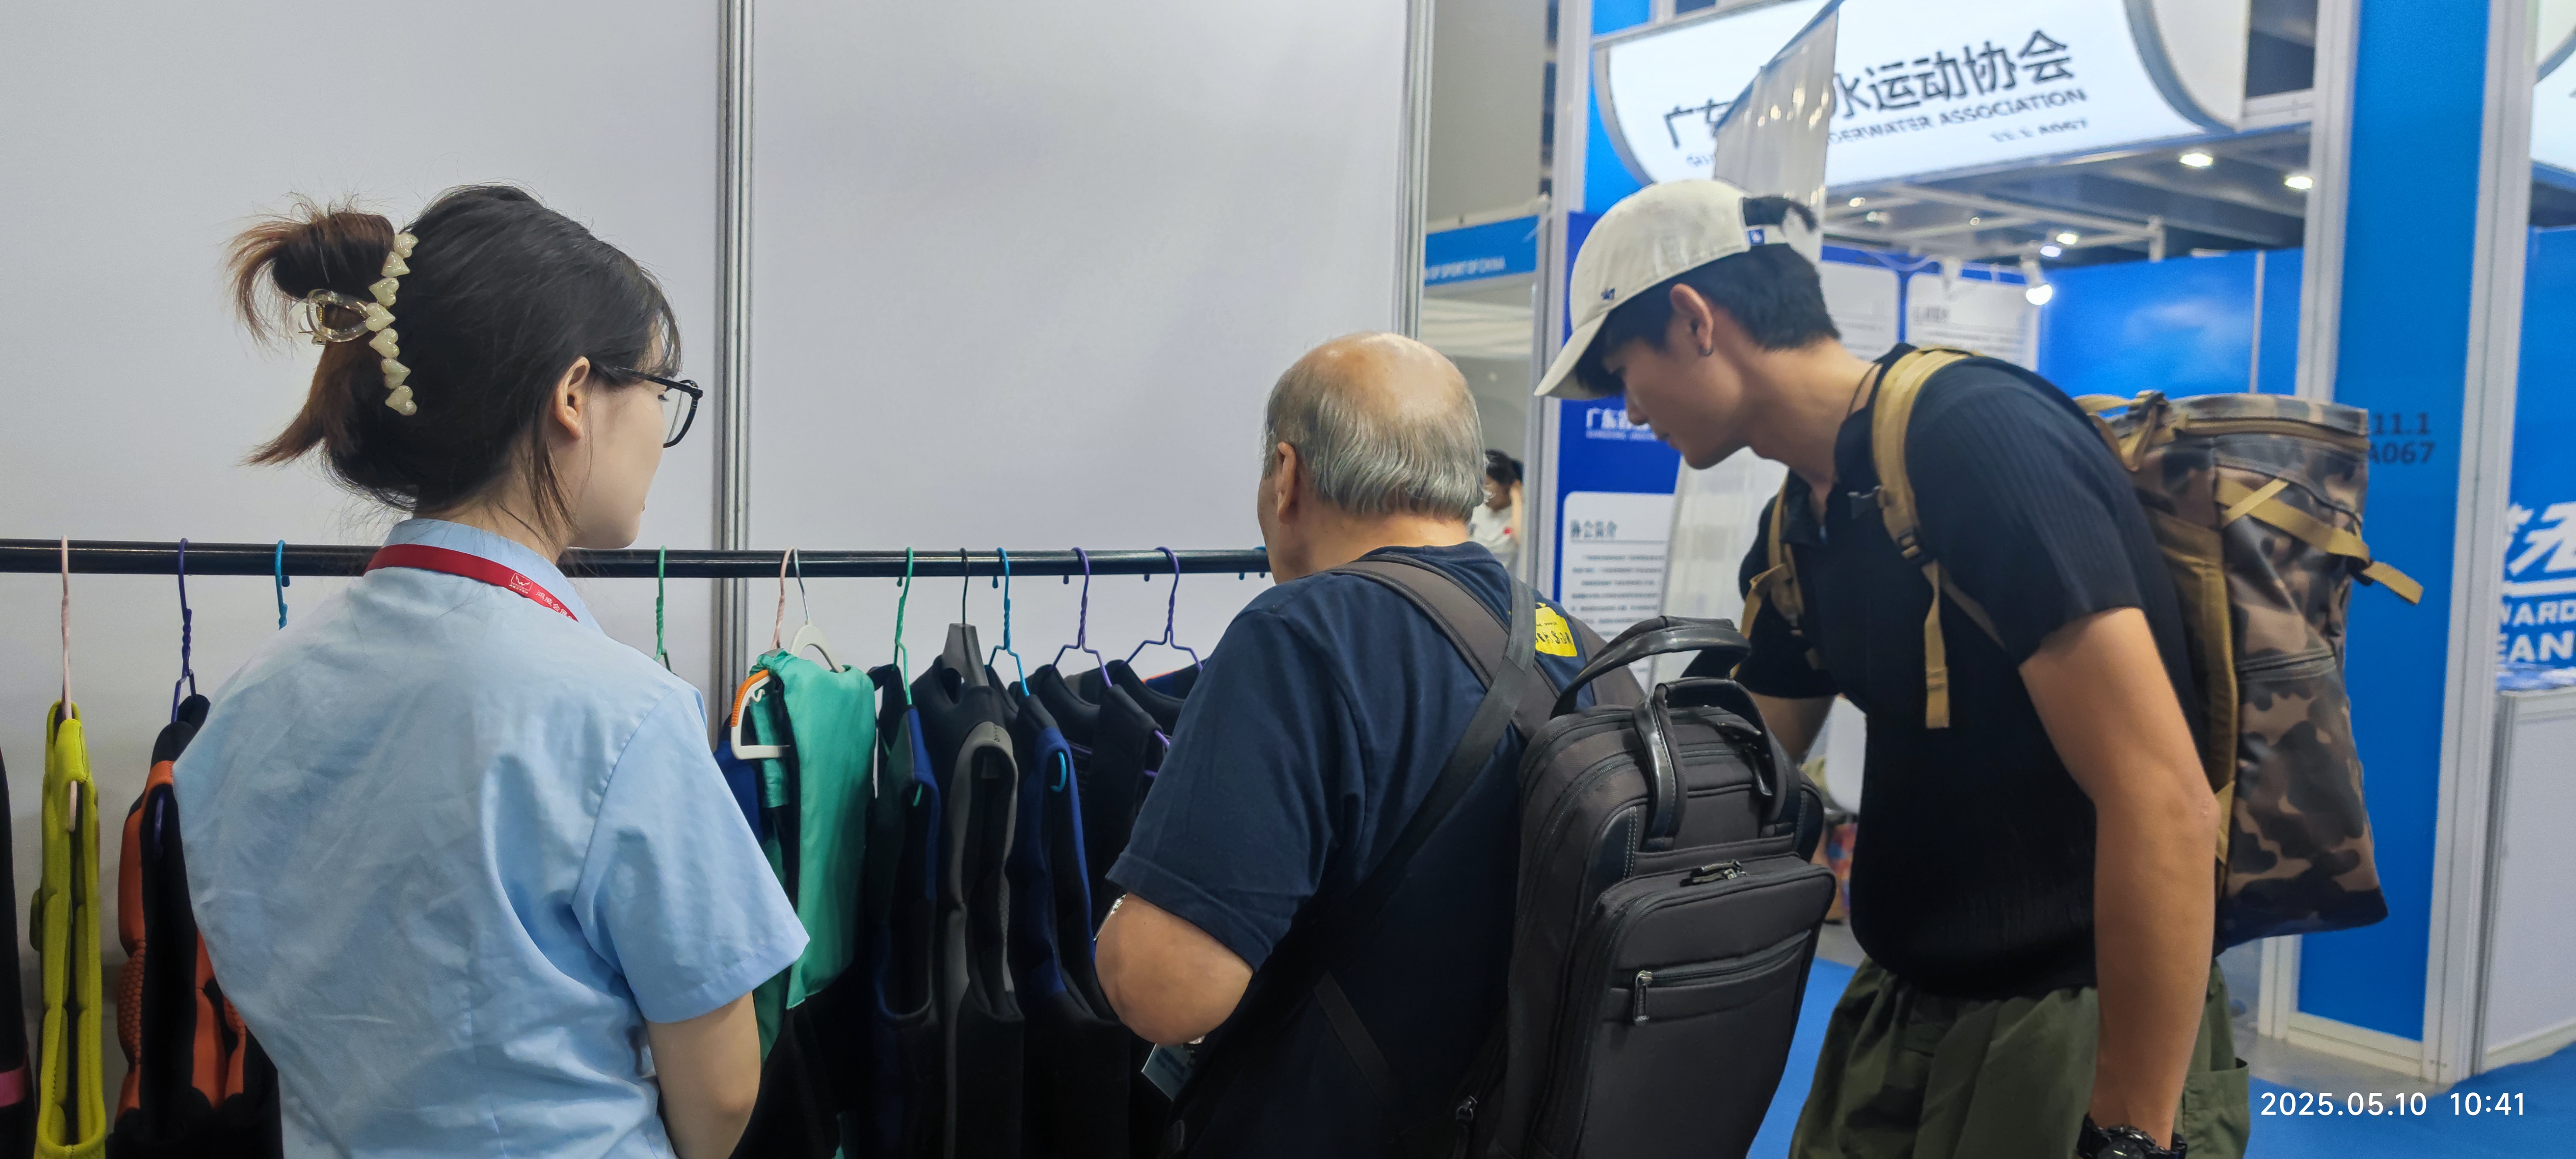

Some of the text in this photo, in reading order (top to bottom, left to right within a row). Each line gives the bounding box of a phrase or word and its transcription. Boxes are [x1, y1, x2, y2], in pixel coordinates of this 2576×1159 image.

[1828, 88, 2089, 145] DERWATER ASSOCIATION
[2373, 412, 2430, 435] 11.1
[2369, 442, 2435, 464] A067
[2497, 630, 2575, 663] EAN
